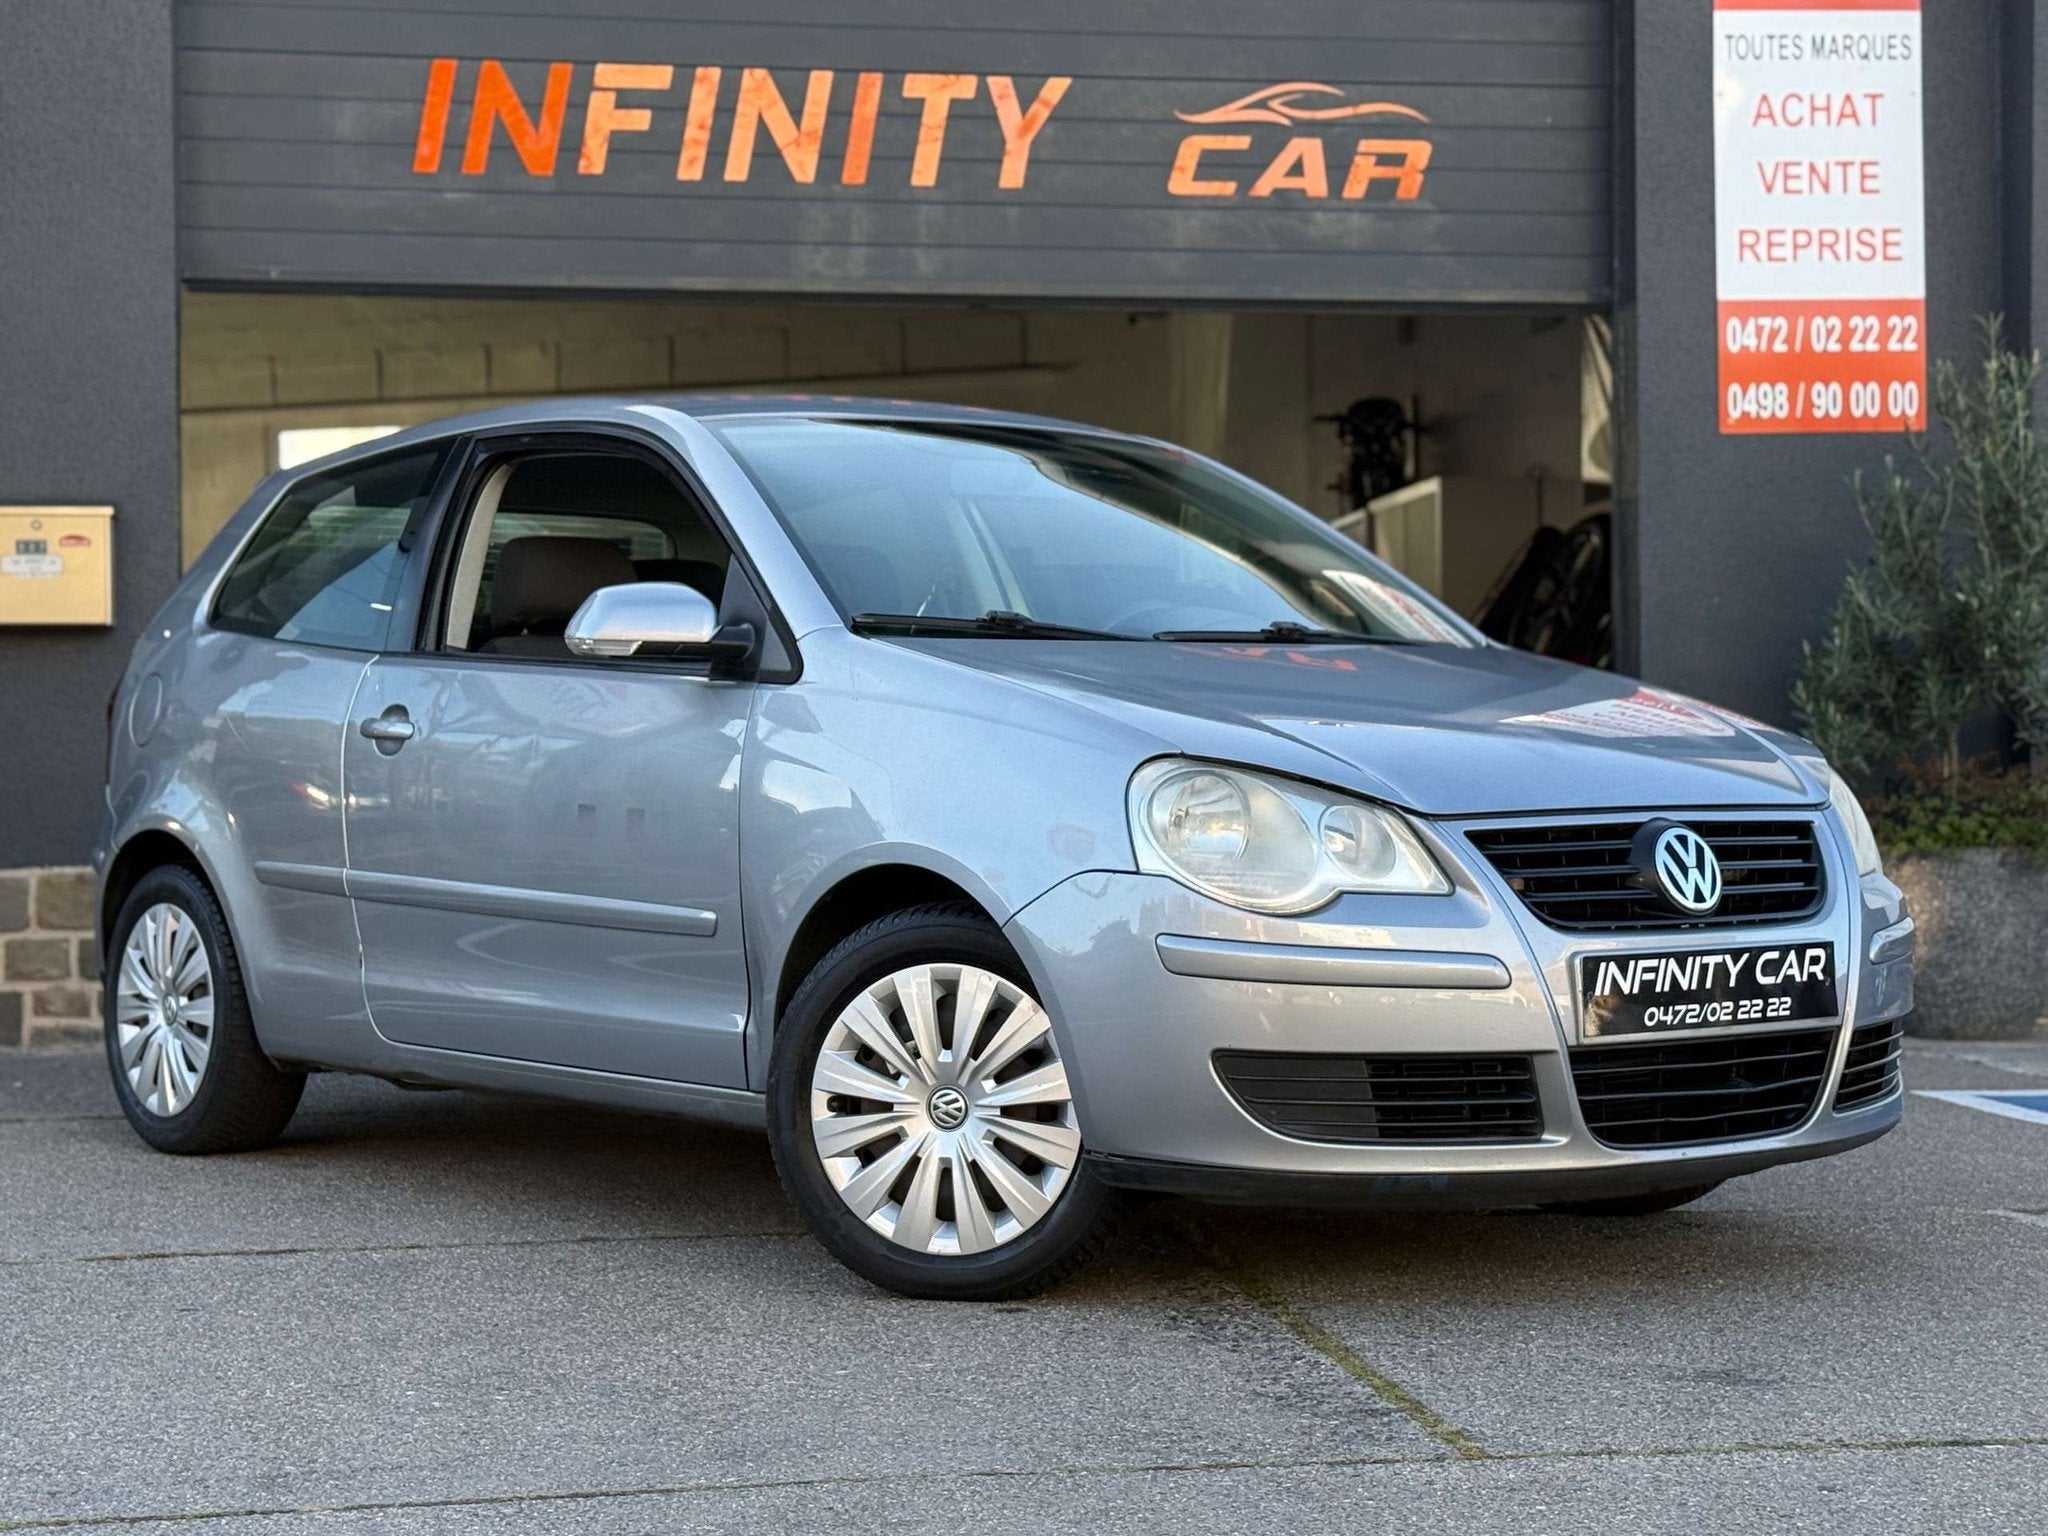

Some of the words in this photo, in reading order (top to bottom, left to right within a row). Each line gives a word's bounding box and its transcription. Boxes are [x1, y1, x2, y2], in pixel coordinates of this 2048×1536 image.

[1725, 34, 1804, 60] TOUTES
[1811, 34, 1912, 61] MARQUES
[1752, 93, 1884, 128] ACHAT
[412, 57, 1072, 190] INFINITY
[1168, 136, 1433, 200] CAR
[1757, 160, 1880, 195] VENTE
[1737, 228, 1903, 262] REPRISE
[1726, 316, 1789, 354] 0472
[1810, 315, 1842, 353] 02
[1848, 315, 1881, 352] 22
[1887, 315, 1919, 352] 22
[1727, 382, 1790, 420] 0498
[1811, 382, 1842, 419] 90
[1850, 382, 1881, 419] 00
[1887, 382, 1919, 419] 00
[1594, 952, 1750, 997] INFINITY
[1755, 947, 1827, 985] CAR
[1643, 1000, 1733, 1027] 0472/02
[1737, 999, 1763, 1020] 22
[1766, 996, 1792, 1017] 22
